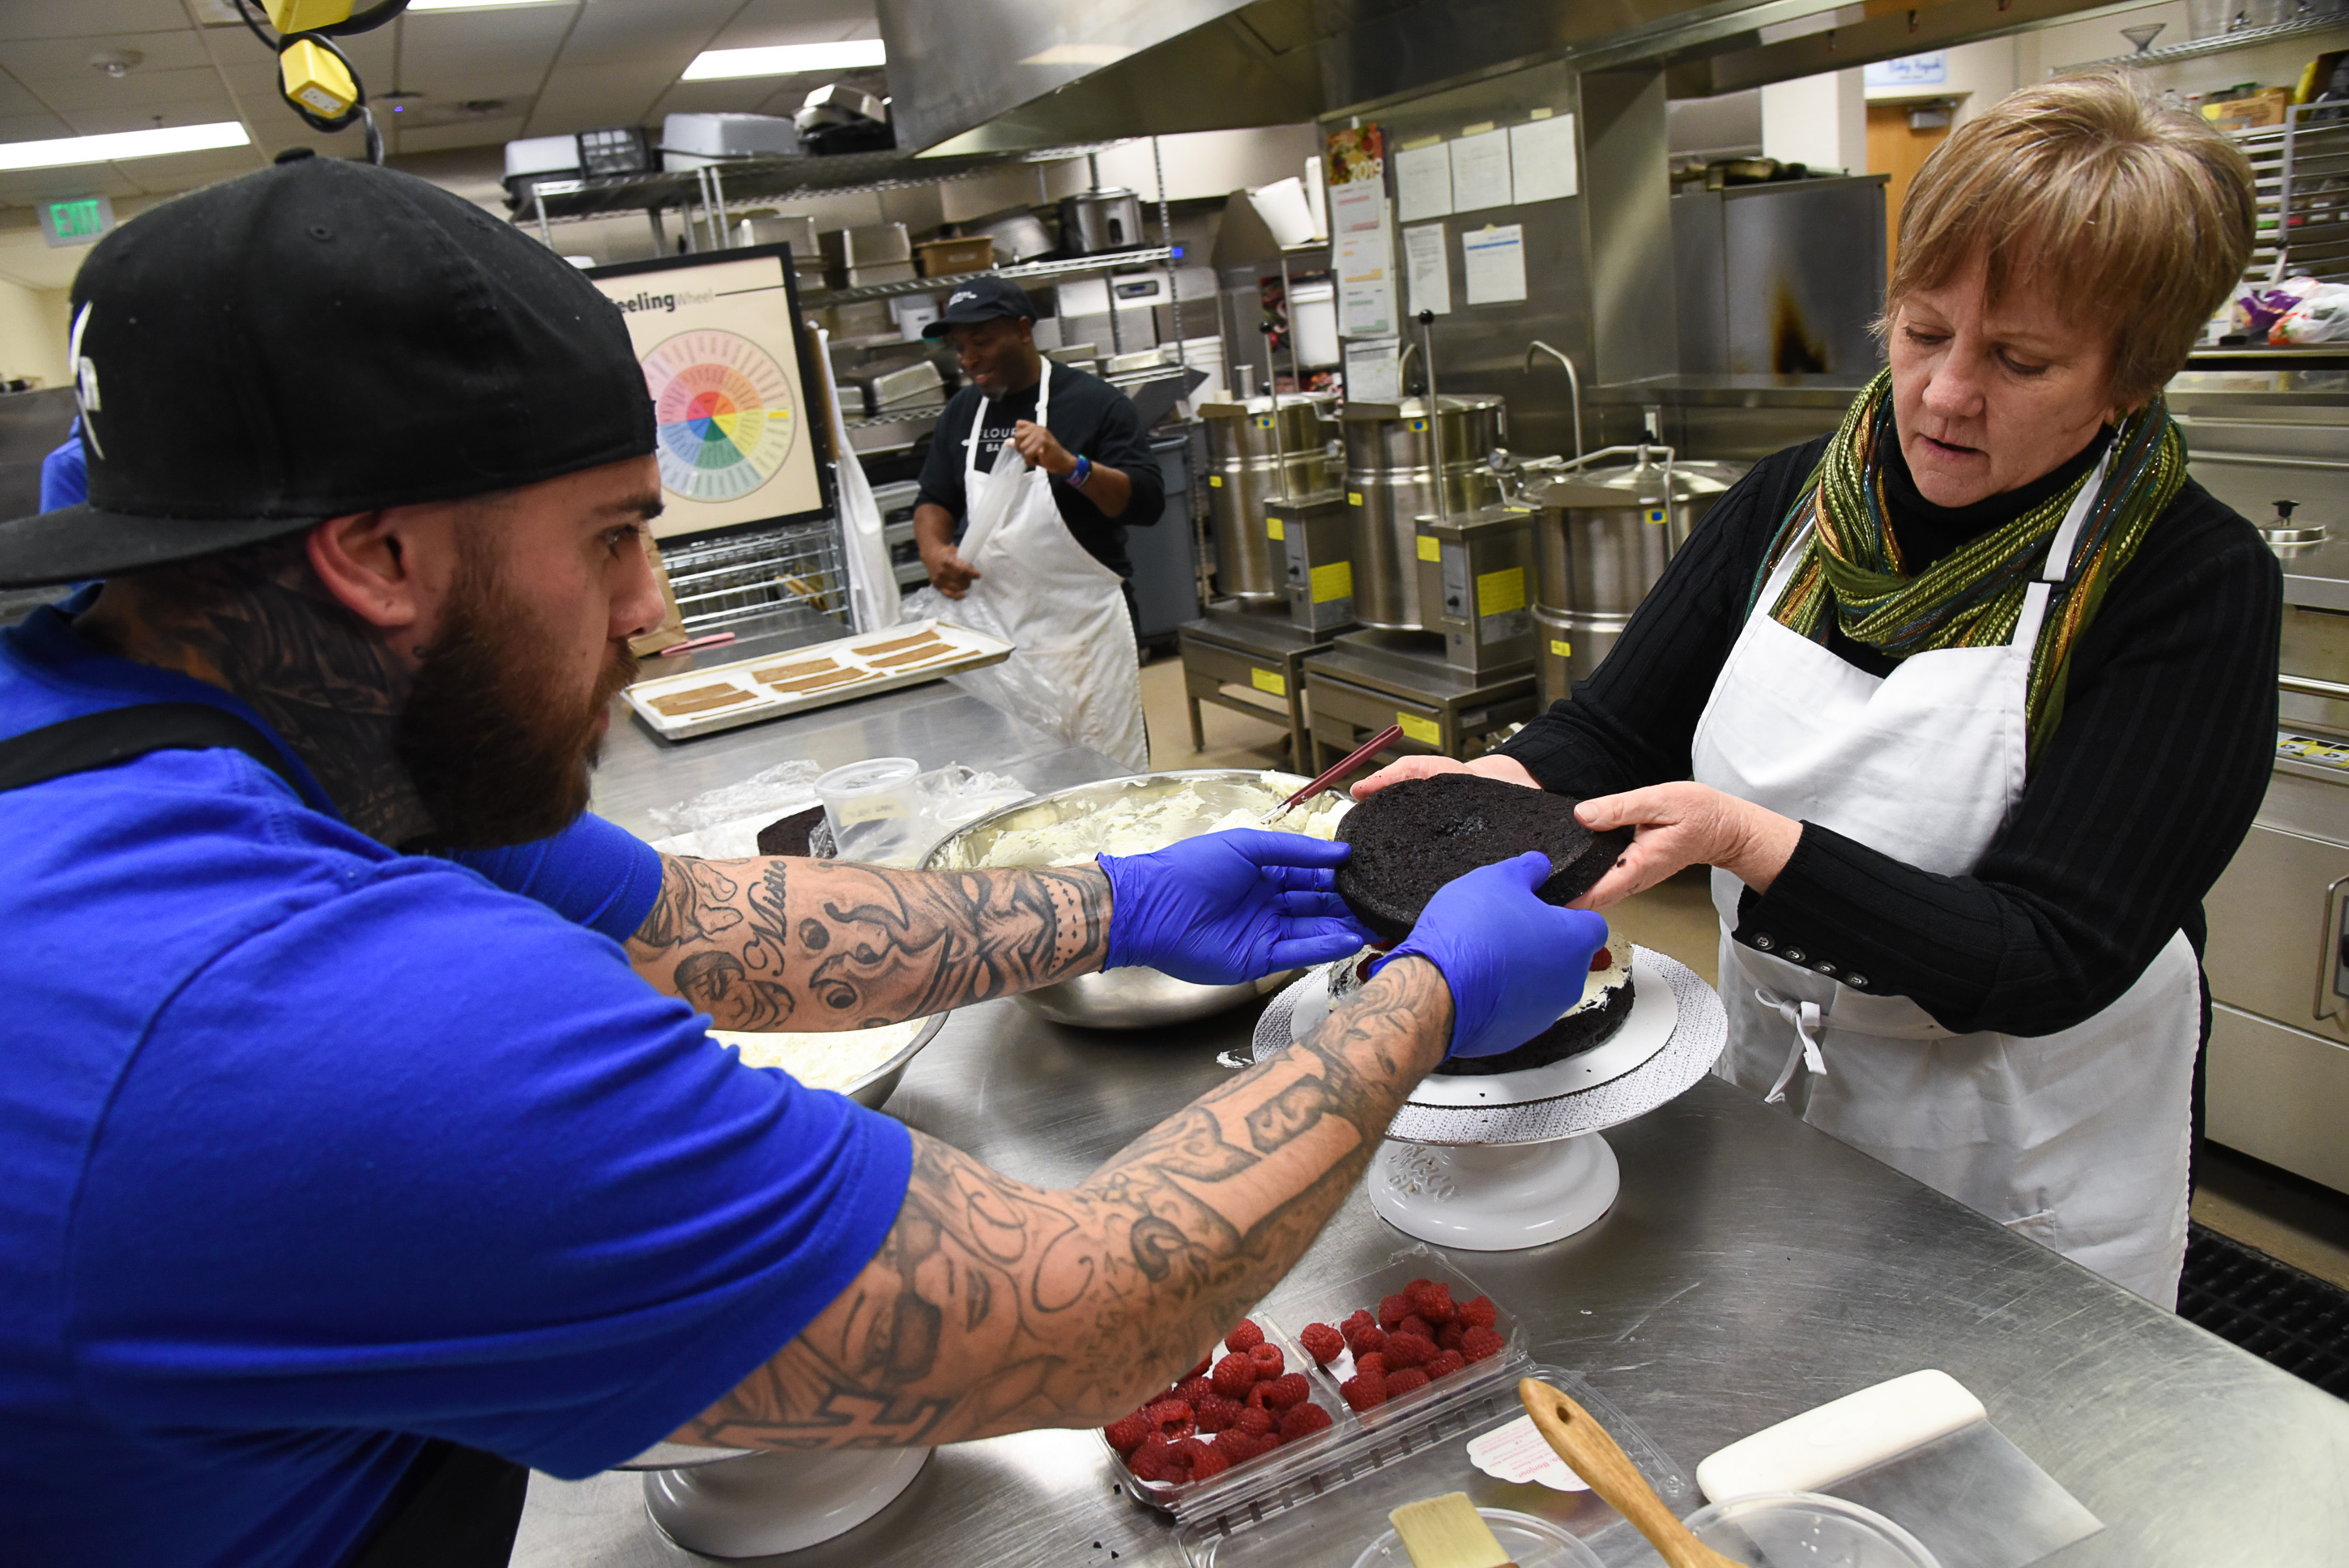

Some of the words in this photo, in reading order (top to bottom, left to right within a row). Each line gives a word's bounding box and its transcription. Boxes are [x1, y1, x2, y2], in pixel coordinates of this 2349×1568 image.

[49, 199, 102, 238] EXIT
[610, 292, 676, 313] eeling
[1514, 1461, 1550, 1478] Bonjour.
